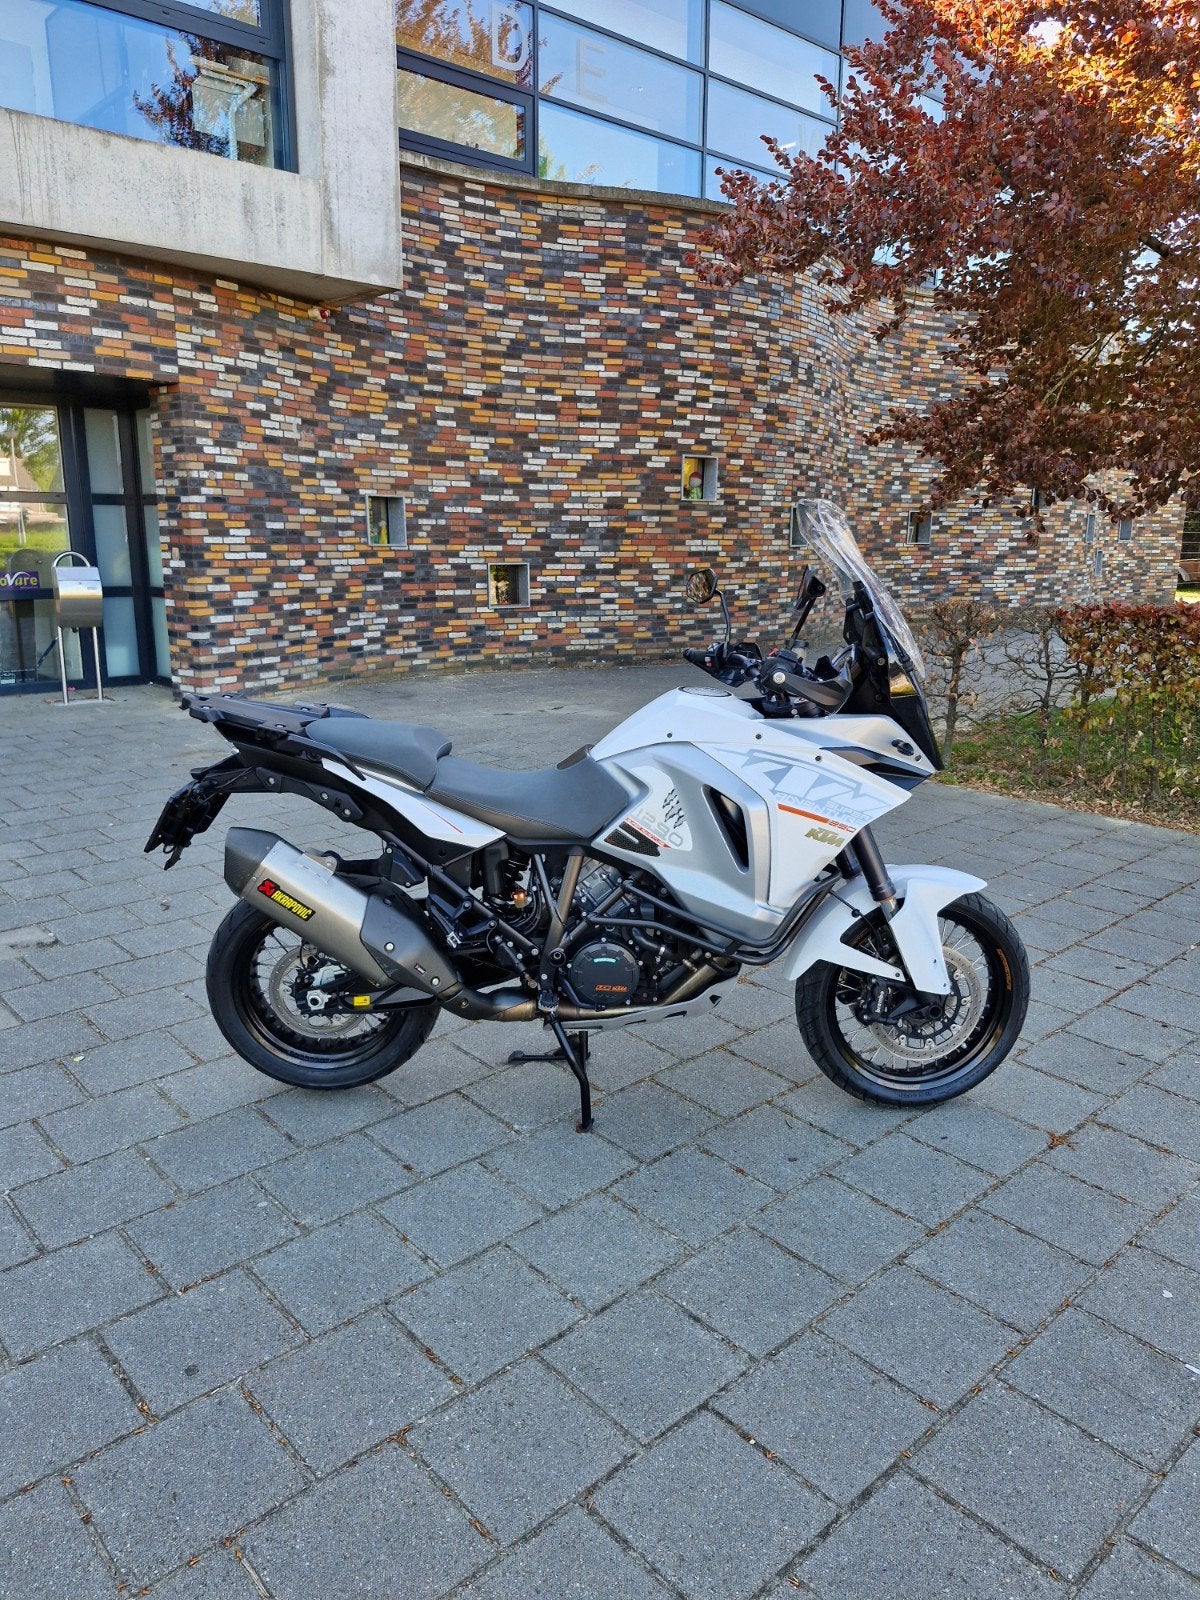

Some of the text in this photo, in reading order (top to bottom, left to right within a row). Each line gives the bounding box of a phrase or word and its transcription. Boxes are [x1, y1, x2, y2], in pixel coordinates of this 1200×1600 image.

[775, 792, 865, 826] ADVENTURE
[826, 800, 873, 821] SUPER
[805, 827, 846, 848] KTM
